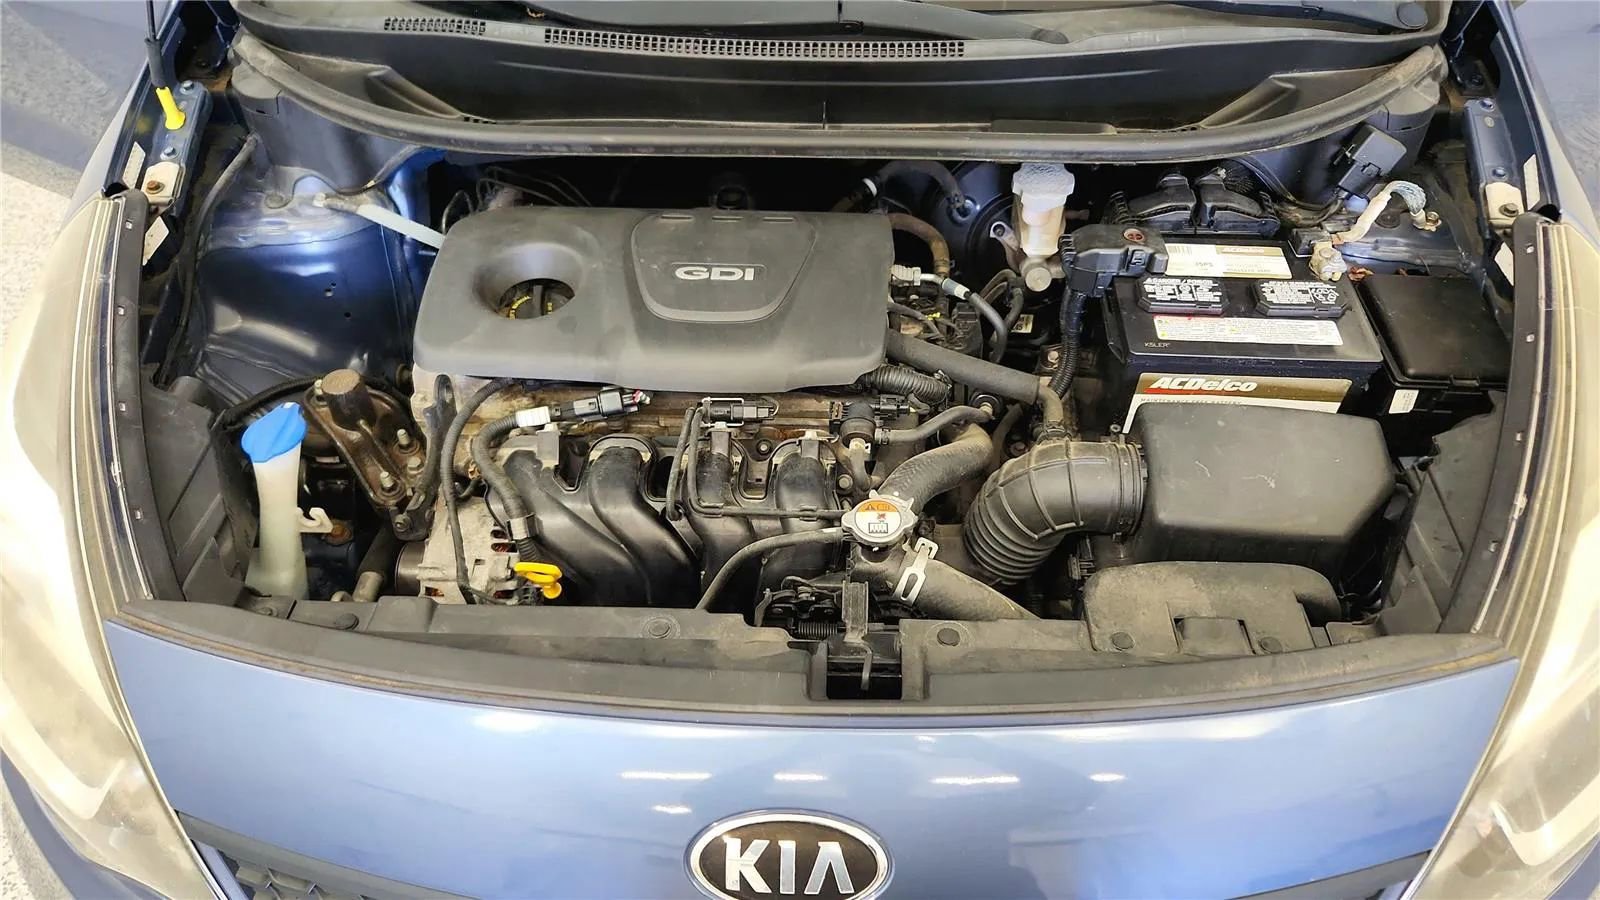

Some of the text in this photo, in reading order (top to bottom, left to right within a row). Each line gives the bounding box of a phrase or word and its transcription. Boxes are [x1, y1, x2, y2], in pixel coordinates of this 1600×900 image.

[675, 266, 754, 281] GDI
[1148, 376, 1258, 391] ACDelco
[723, 837, 855, 894] KIA
